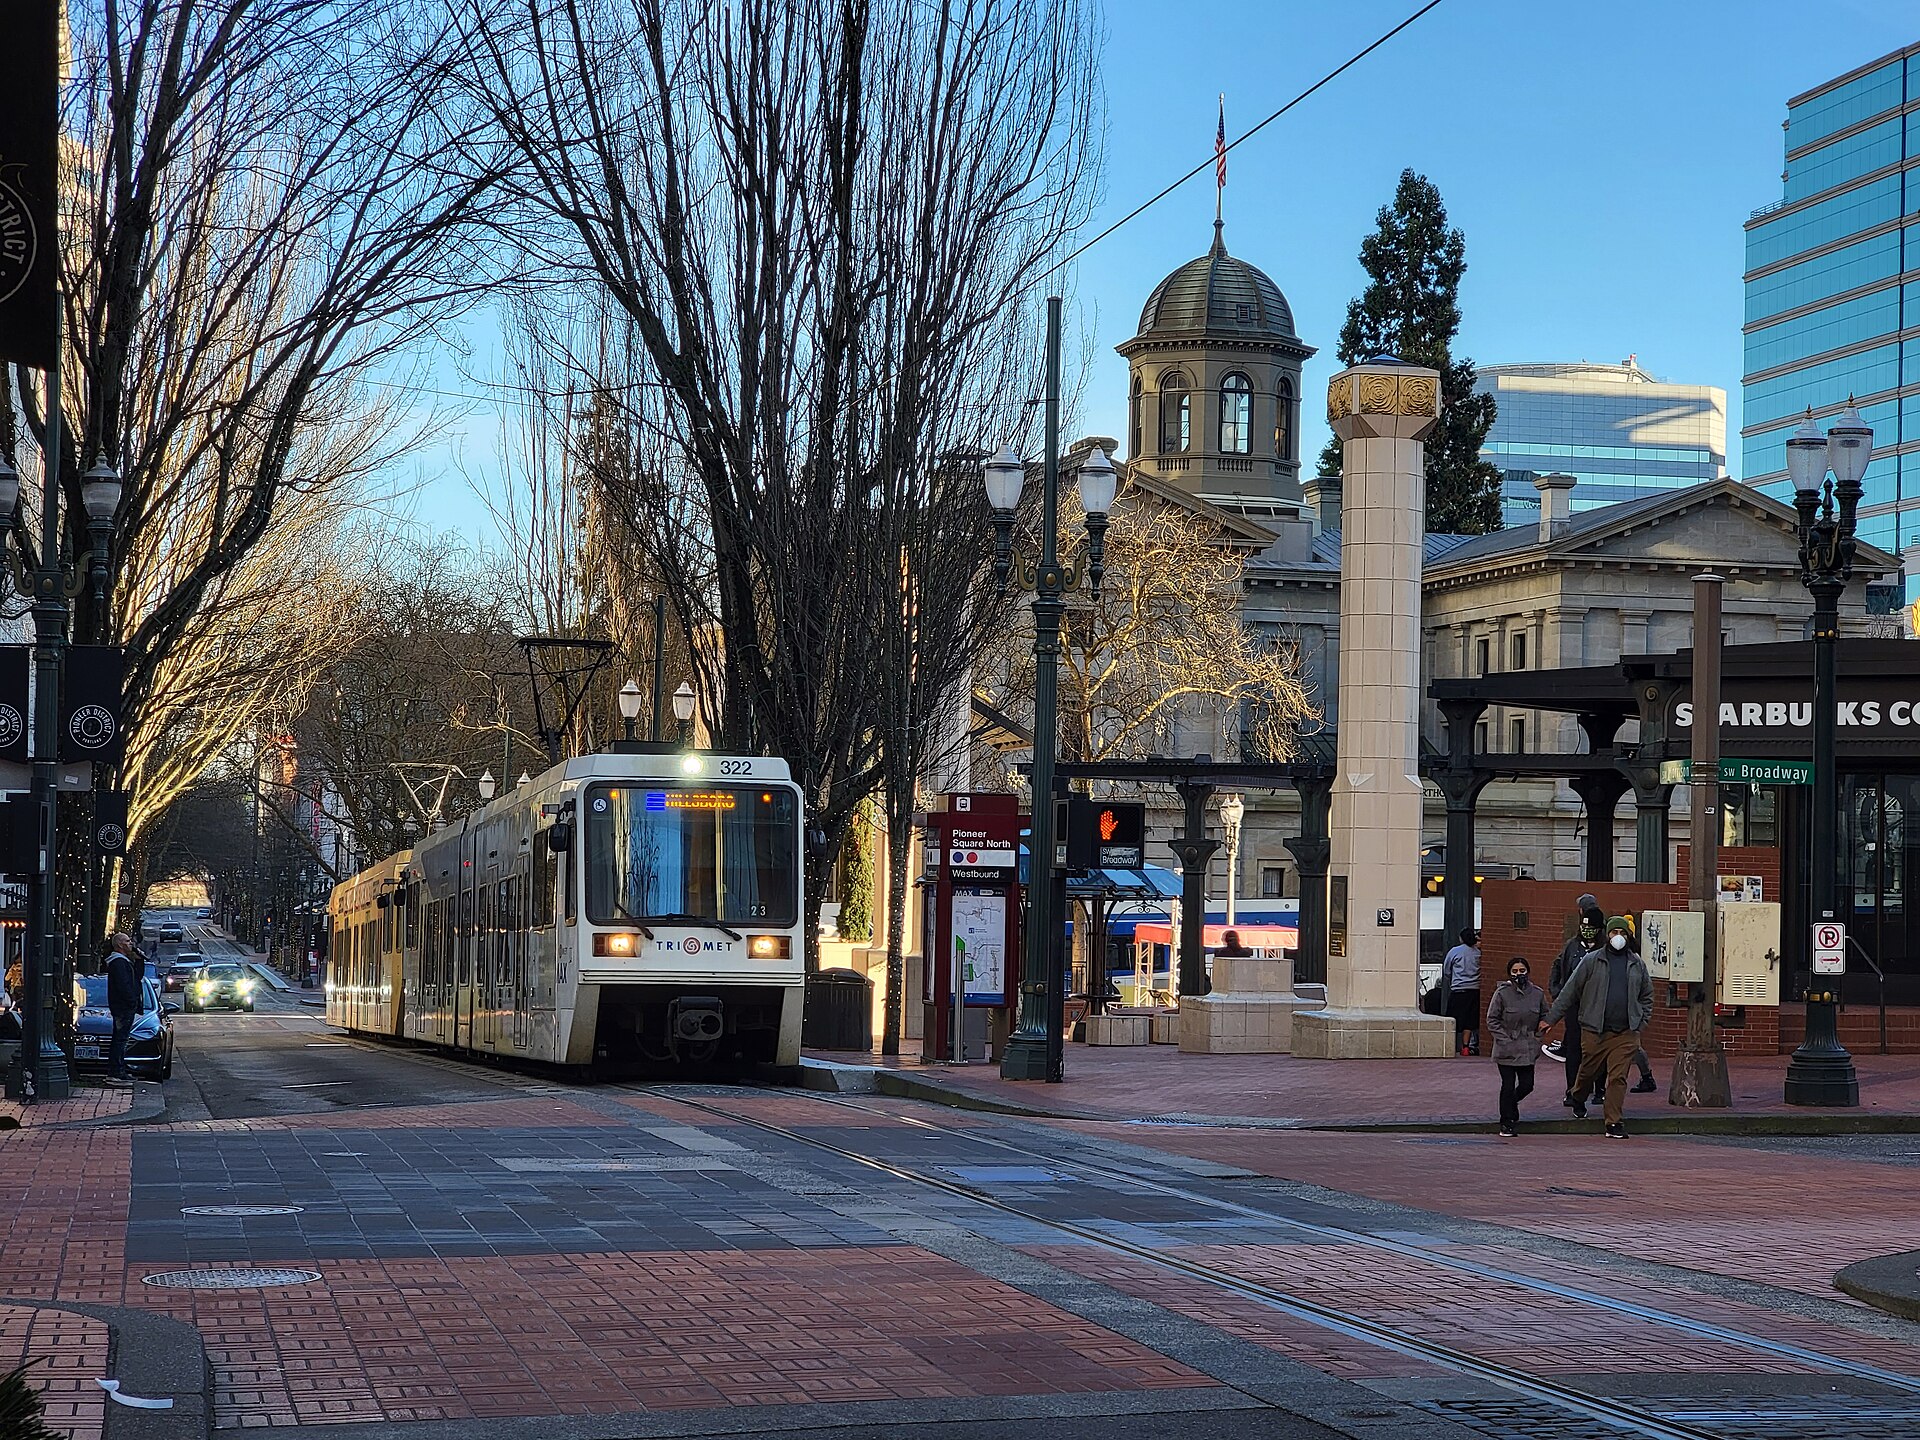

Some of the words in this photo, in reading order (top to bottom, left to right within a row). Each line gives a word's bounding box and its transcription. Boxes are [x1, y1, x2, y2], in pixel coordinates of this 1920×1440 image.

[1675, 701, 1881, 726] SARBUKS
[73, 708, 91, 734] PIONEER
[93, 708, 112, 734] DISTRICT
[720, 760, 753, 776] 322
[1723, 767, 1735, 777] SW
[1741, 764, 1808, 783] Broadway
[952, 829, 987, 838] Pioneer
[952, 839, 984, 849] Square
[986, 840, 1011, 848] North
[1102, 856, 1137, 866] Broadway
[952, 869, 1000, 879] Westbound
[955, 889, 974, 897] MAX
